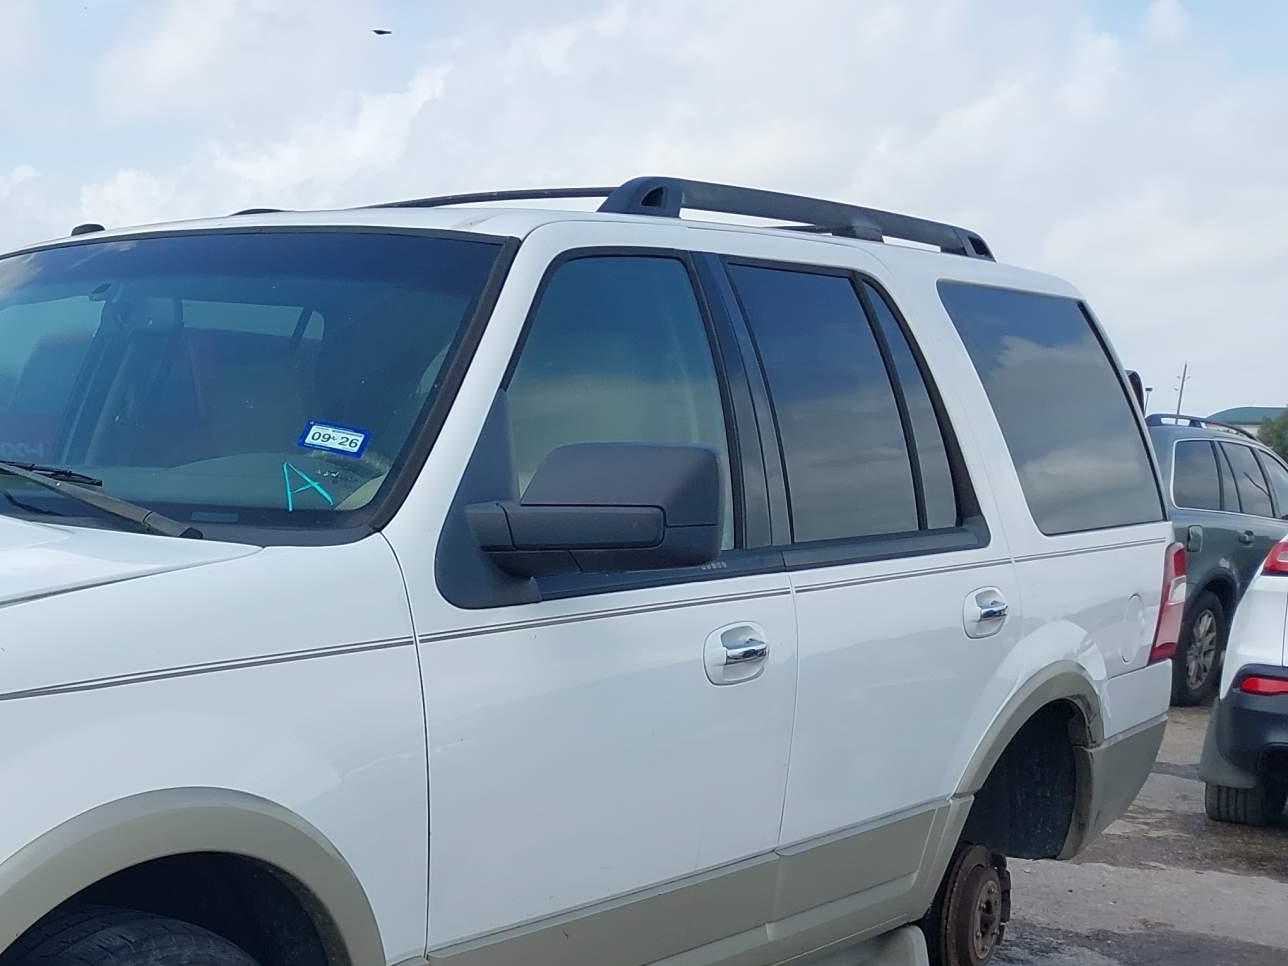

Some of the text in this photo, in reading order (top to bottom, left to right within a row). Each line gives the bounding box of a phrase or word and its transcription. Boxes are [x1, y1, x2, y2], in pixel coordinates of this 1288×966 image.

[311, 431, 332, 443] 09
[338, 436, 360, 449] 26
[282, 461, 334, 512] A
